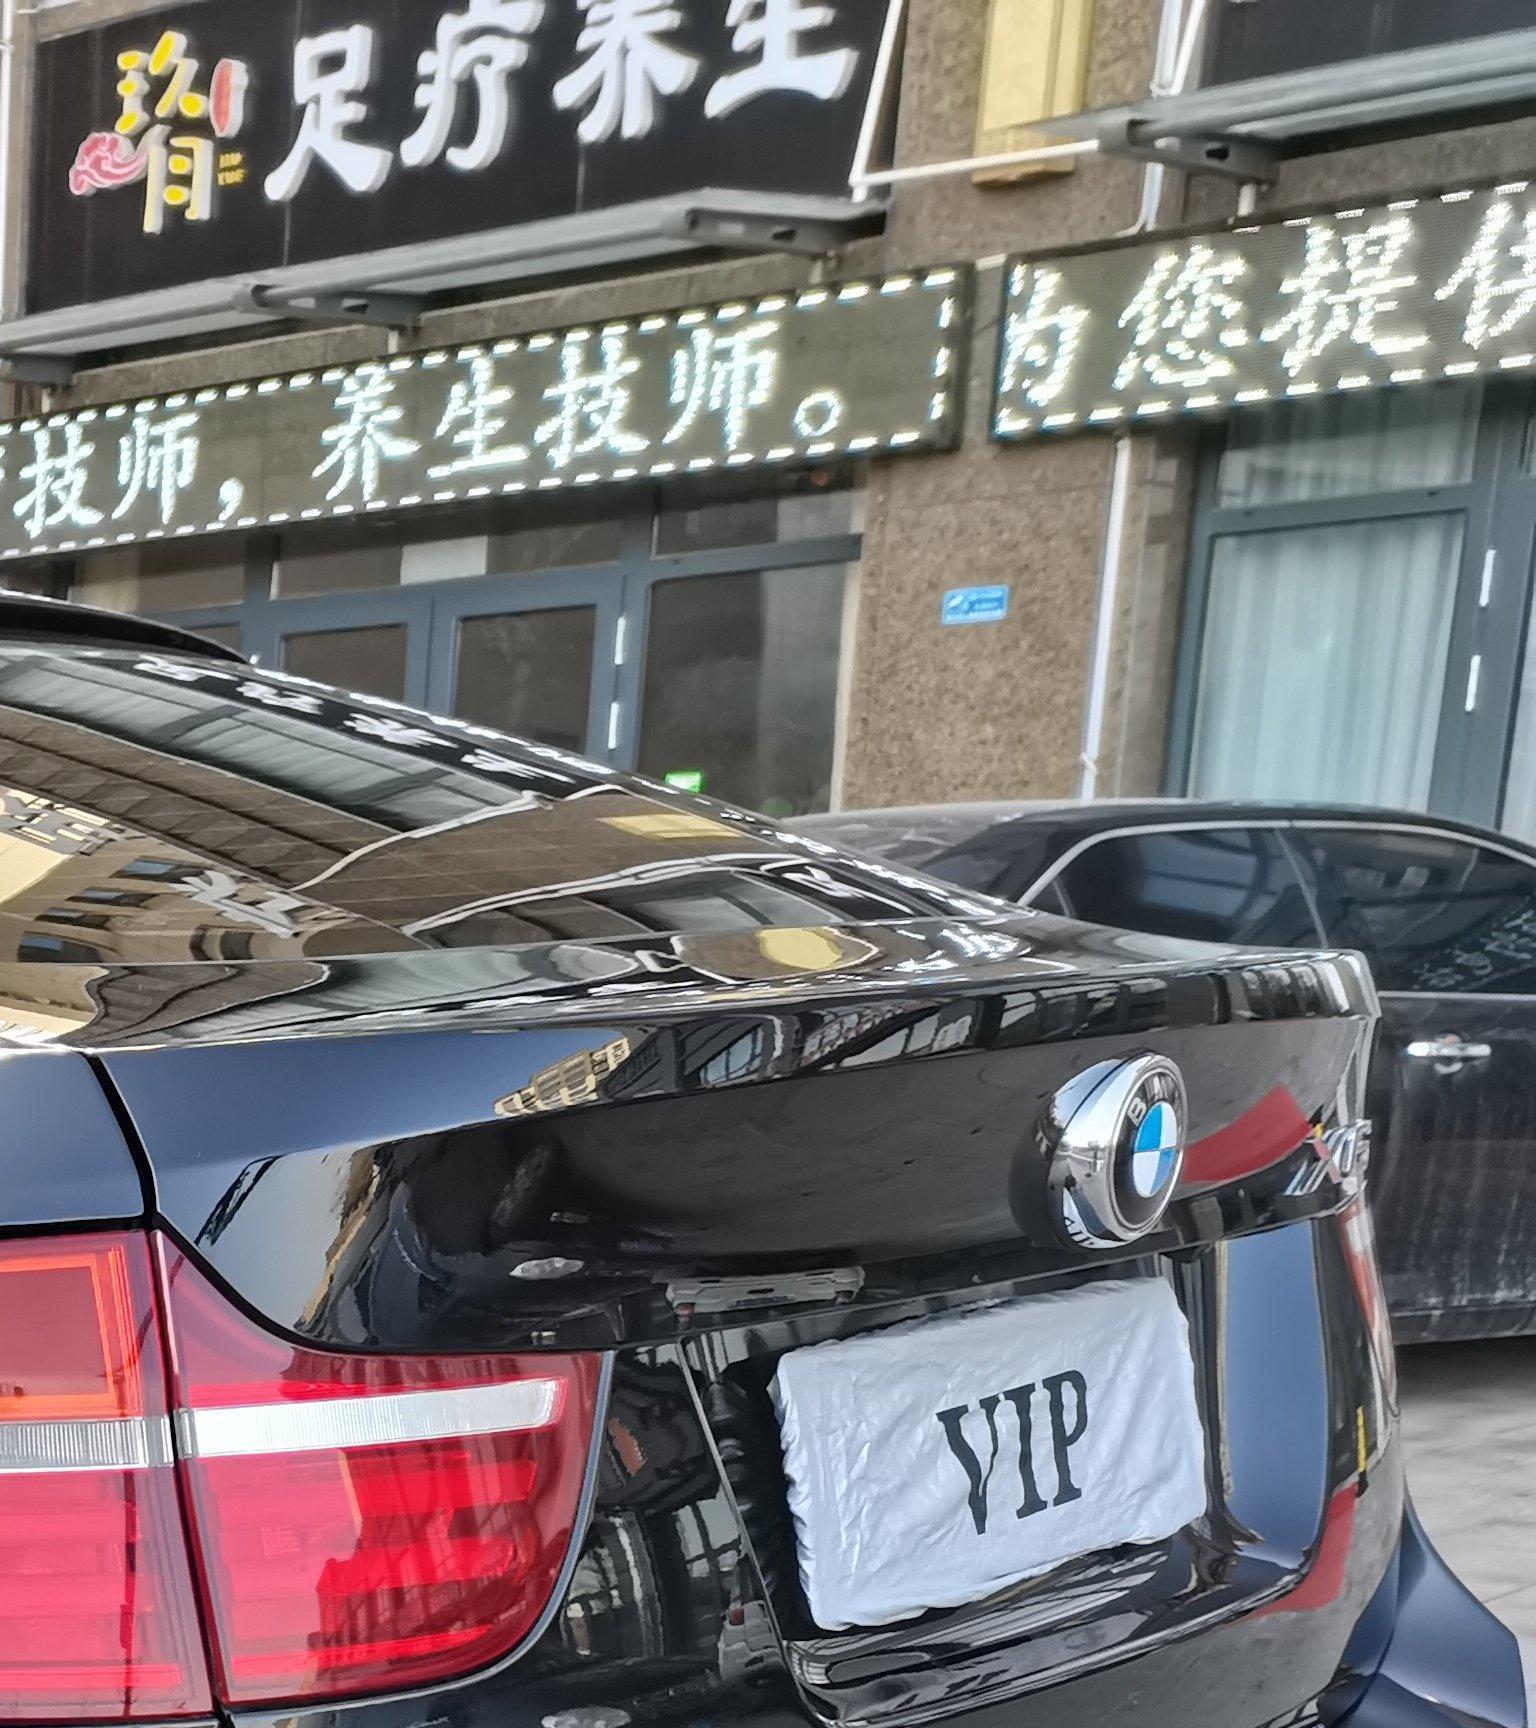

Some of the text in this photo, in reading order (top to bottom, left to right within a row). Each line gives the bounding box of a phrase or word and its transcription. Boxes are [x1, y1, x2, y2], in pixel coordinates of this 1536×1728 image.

[265, 0, 858, 201] 足疗养生
[936, 1369, 1088, 1536] VIP
